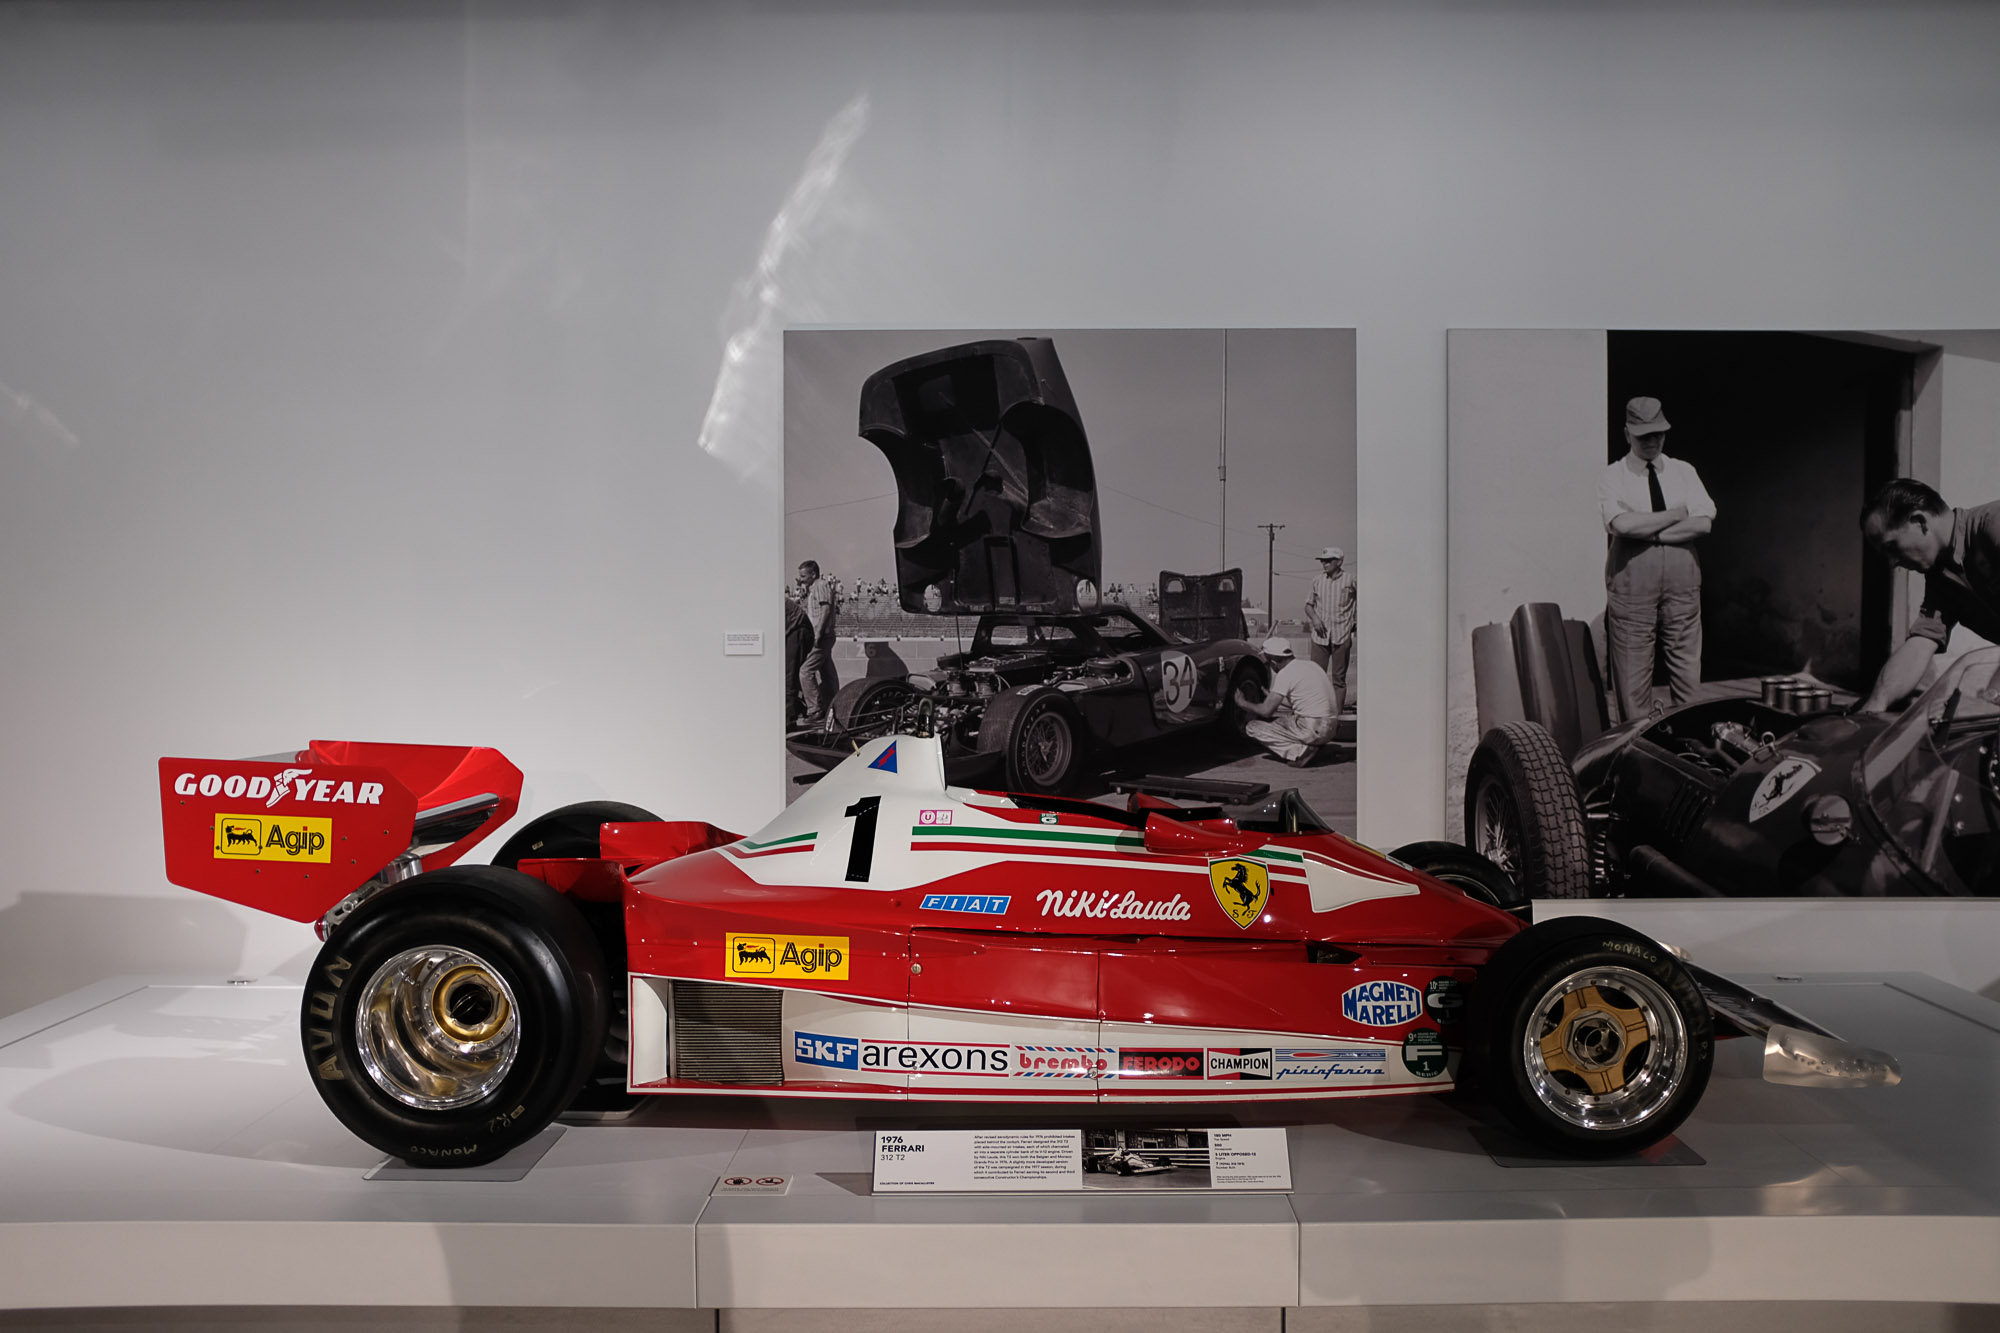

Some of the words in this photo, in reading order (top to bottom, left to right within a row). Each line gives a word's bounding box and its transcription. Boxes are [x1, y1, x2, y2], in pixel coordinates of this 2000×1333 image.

[1162, 654, 1197, 706] 34
[265, 824, 326, 856] Agip
[844, 795, 881, 883] 1
[926, 898, 1004, 912] FIAT
[1110, 890, 1191, 920] Lauda
[780, 942, 842, 973] Agip
[1602, 940, 1657, 962] MONACO
[1343, 982, 1422, 1003] MAGNETI
[1343, 1004, 1422, 1026] MARELLI
[796, 1038, 858, 1062] SKF
[862, 1044, 1008, 1071] arexons
[1020, 1054, 1108, 1070] brembo
[1122, 1056, 1200, 1070] FERODO
[1210, 1058, 1268, 1070] CHAMPION
[1276, 1064, 1384, 1080] pininfarina
